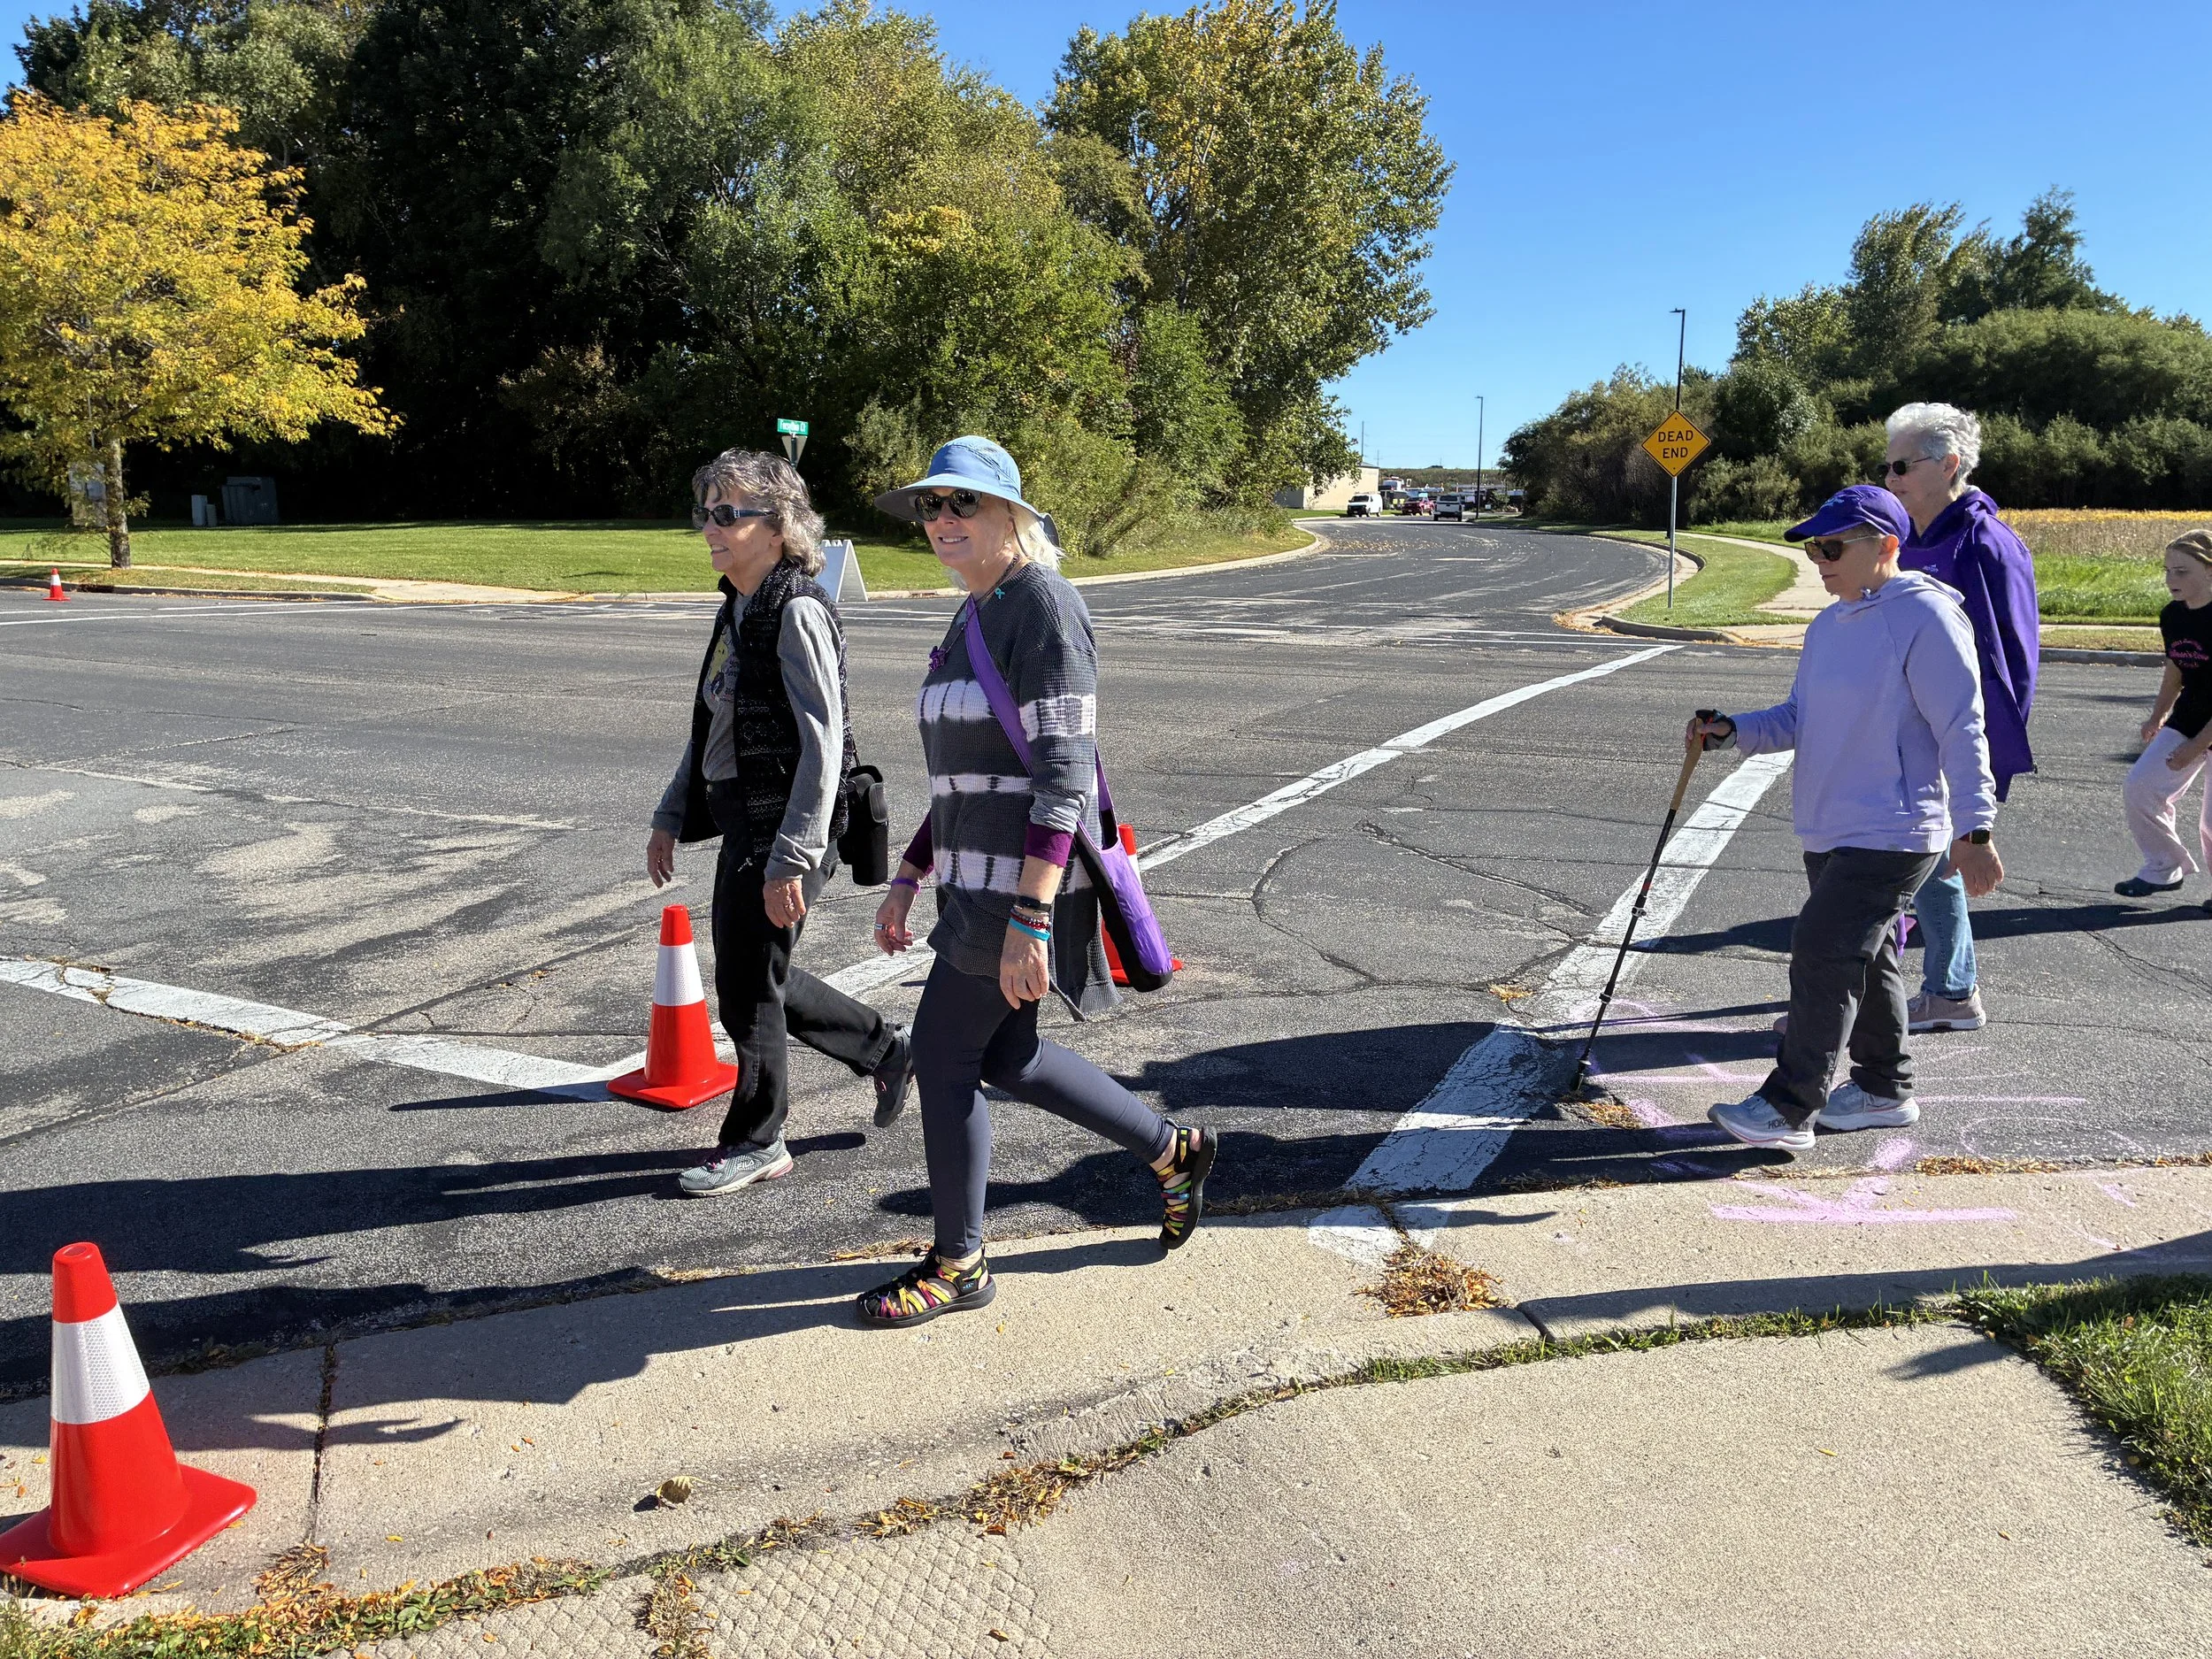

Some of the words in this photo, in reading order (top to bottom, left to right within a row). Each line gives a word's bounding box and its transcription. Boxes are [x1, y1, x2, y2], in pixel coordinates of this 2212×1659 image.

[1658, 430, 1694, 442] DEAD
[1663, 447, 1688, 458] END
[736, 1159, 755, 1171] FILA
